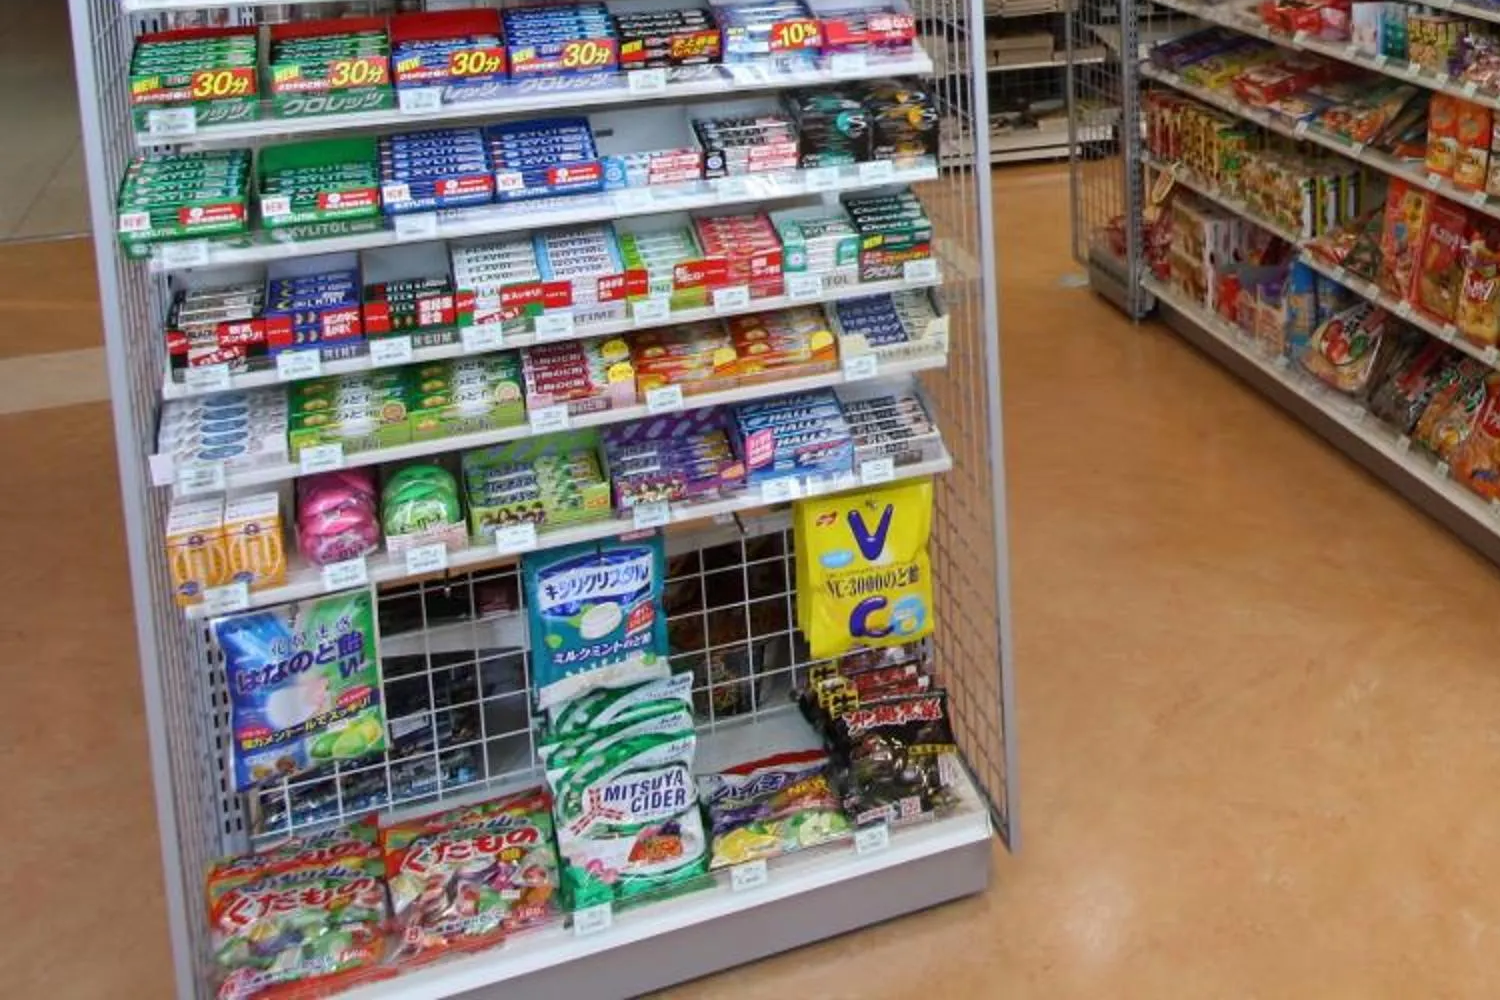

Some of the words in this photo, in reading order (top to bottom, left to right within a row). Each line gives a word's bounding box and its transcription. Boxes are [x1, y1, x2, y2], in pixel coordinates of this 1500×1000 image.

[450, 50, 500, 76] 30分
[562, 42, 609, 67] 30分
[192, 70, 248, 97] 30分
[331, 60, 385, 86] 30分
[282, 92, 385, 119] クロレッツ
[286, 222, 349, 240] XYLITOL
[847, 503, 895, 561] V
[545, 564, 650, 601] キシリクリスタル
[849, 594, 896, 639] C
[603, 769, 685, 803] MITSUYA
[631, 789, 687, 814] CIDER
[400, 826, 540, 873] くだもの
[218, 877, 376, 924] くだもの
